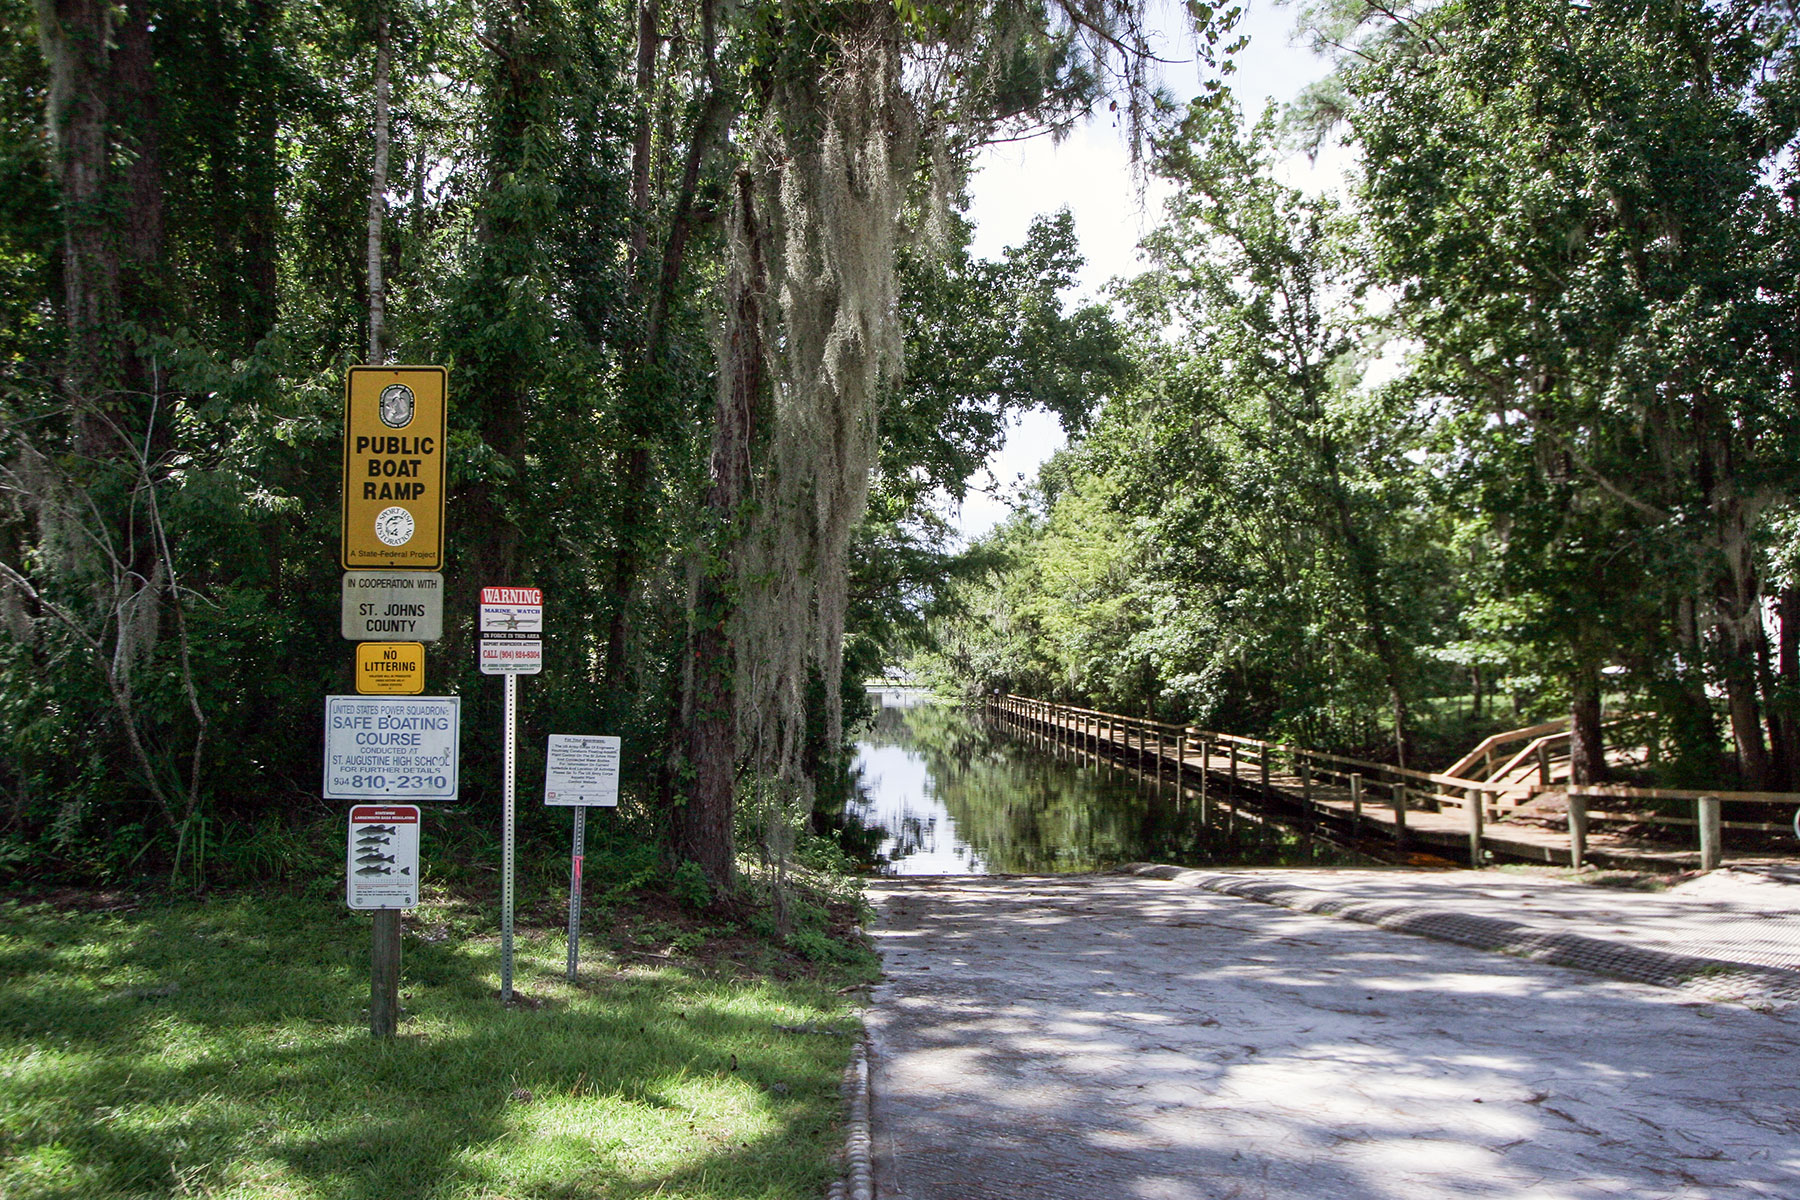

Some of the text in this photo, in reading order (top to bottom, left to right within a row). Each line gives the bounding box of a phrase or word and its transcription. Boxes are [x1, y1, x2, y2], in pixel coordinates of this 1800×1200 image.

[356, 436, 434, 455] PUBLIC
[368, 460, 422, 477] BOAT
[363, 482, 426, 500] RAMP
[380, 508, 413, 526] SPORT FISH
[377, 522, 412, 545] RESTORATION
[348, 579, 437, 589] IN COOPERATION WITH
[483, 589, 540, 604] WARNING
[359, 603, 425, 617] ST. JOHNS
[366, 620, 416, 632] COUNTY
[384, 650, 397, 660] NO
[483, 650, 498, 658] CALL
[500, 650, 514, 660] (904)
[365, 662, 416, 671] LITTERING
[333, 705, 355, 714] UNITED
[356, 705, 378, 714] STATES
[381, 706, 404, 715] POWER
[333, 716, 448, 730] SAFE BOATING
[356, 732, 421, 745] COURSE
[333, 755, 450, 766] ST. AUGUSTINE HIGH SCHOOL
[352, 775, 446, 788] 810-2310
